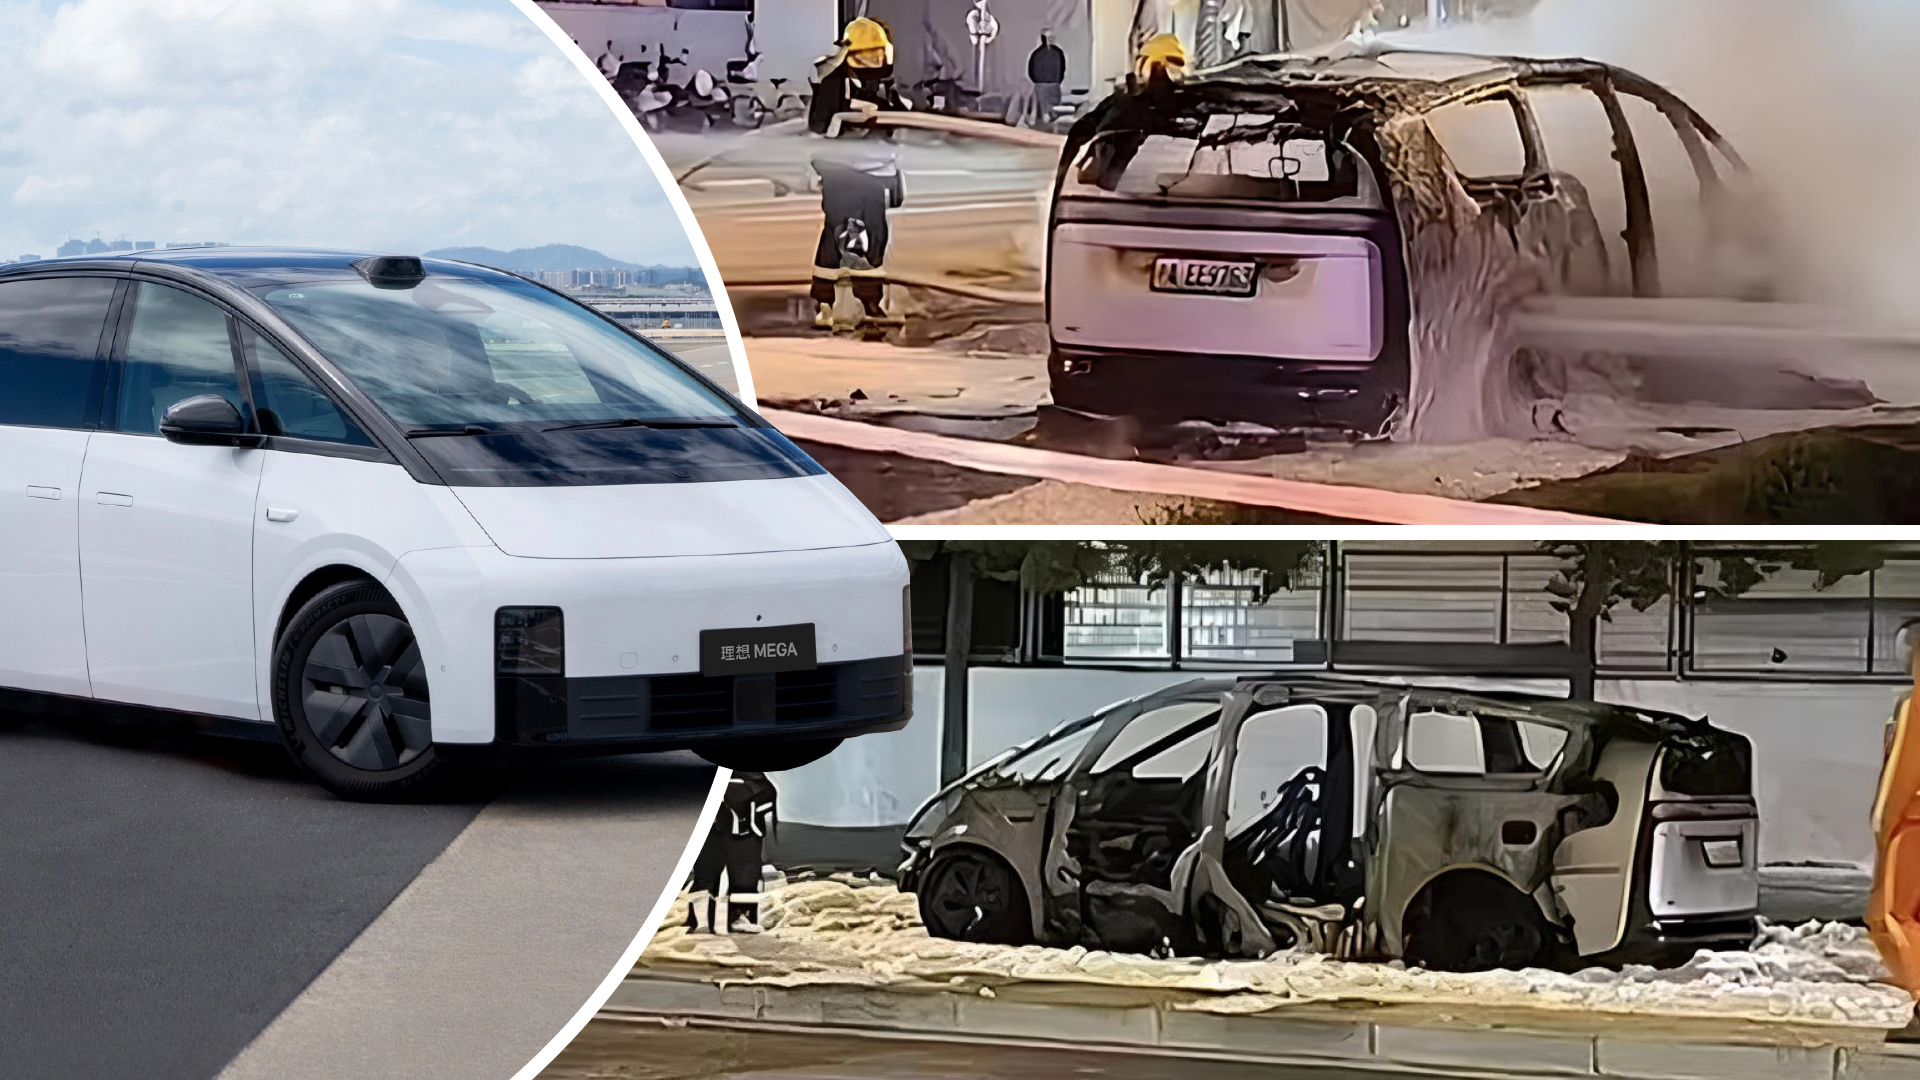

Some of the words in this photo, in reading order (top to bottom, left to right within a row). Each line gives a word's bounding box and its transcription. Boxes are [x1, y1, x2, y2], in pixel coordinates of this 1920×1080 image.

[720, 645, 751, 661] 理想
[753, 642, 798, 659] MEGA
[277, 650, 294, 731] MICHELIN
